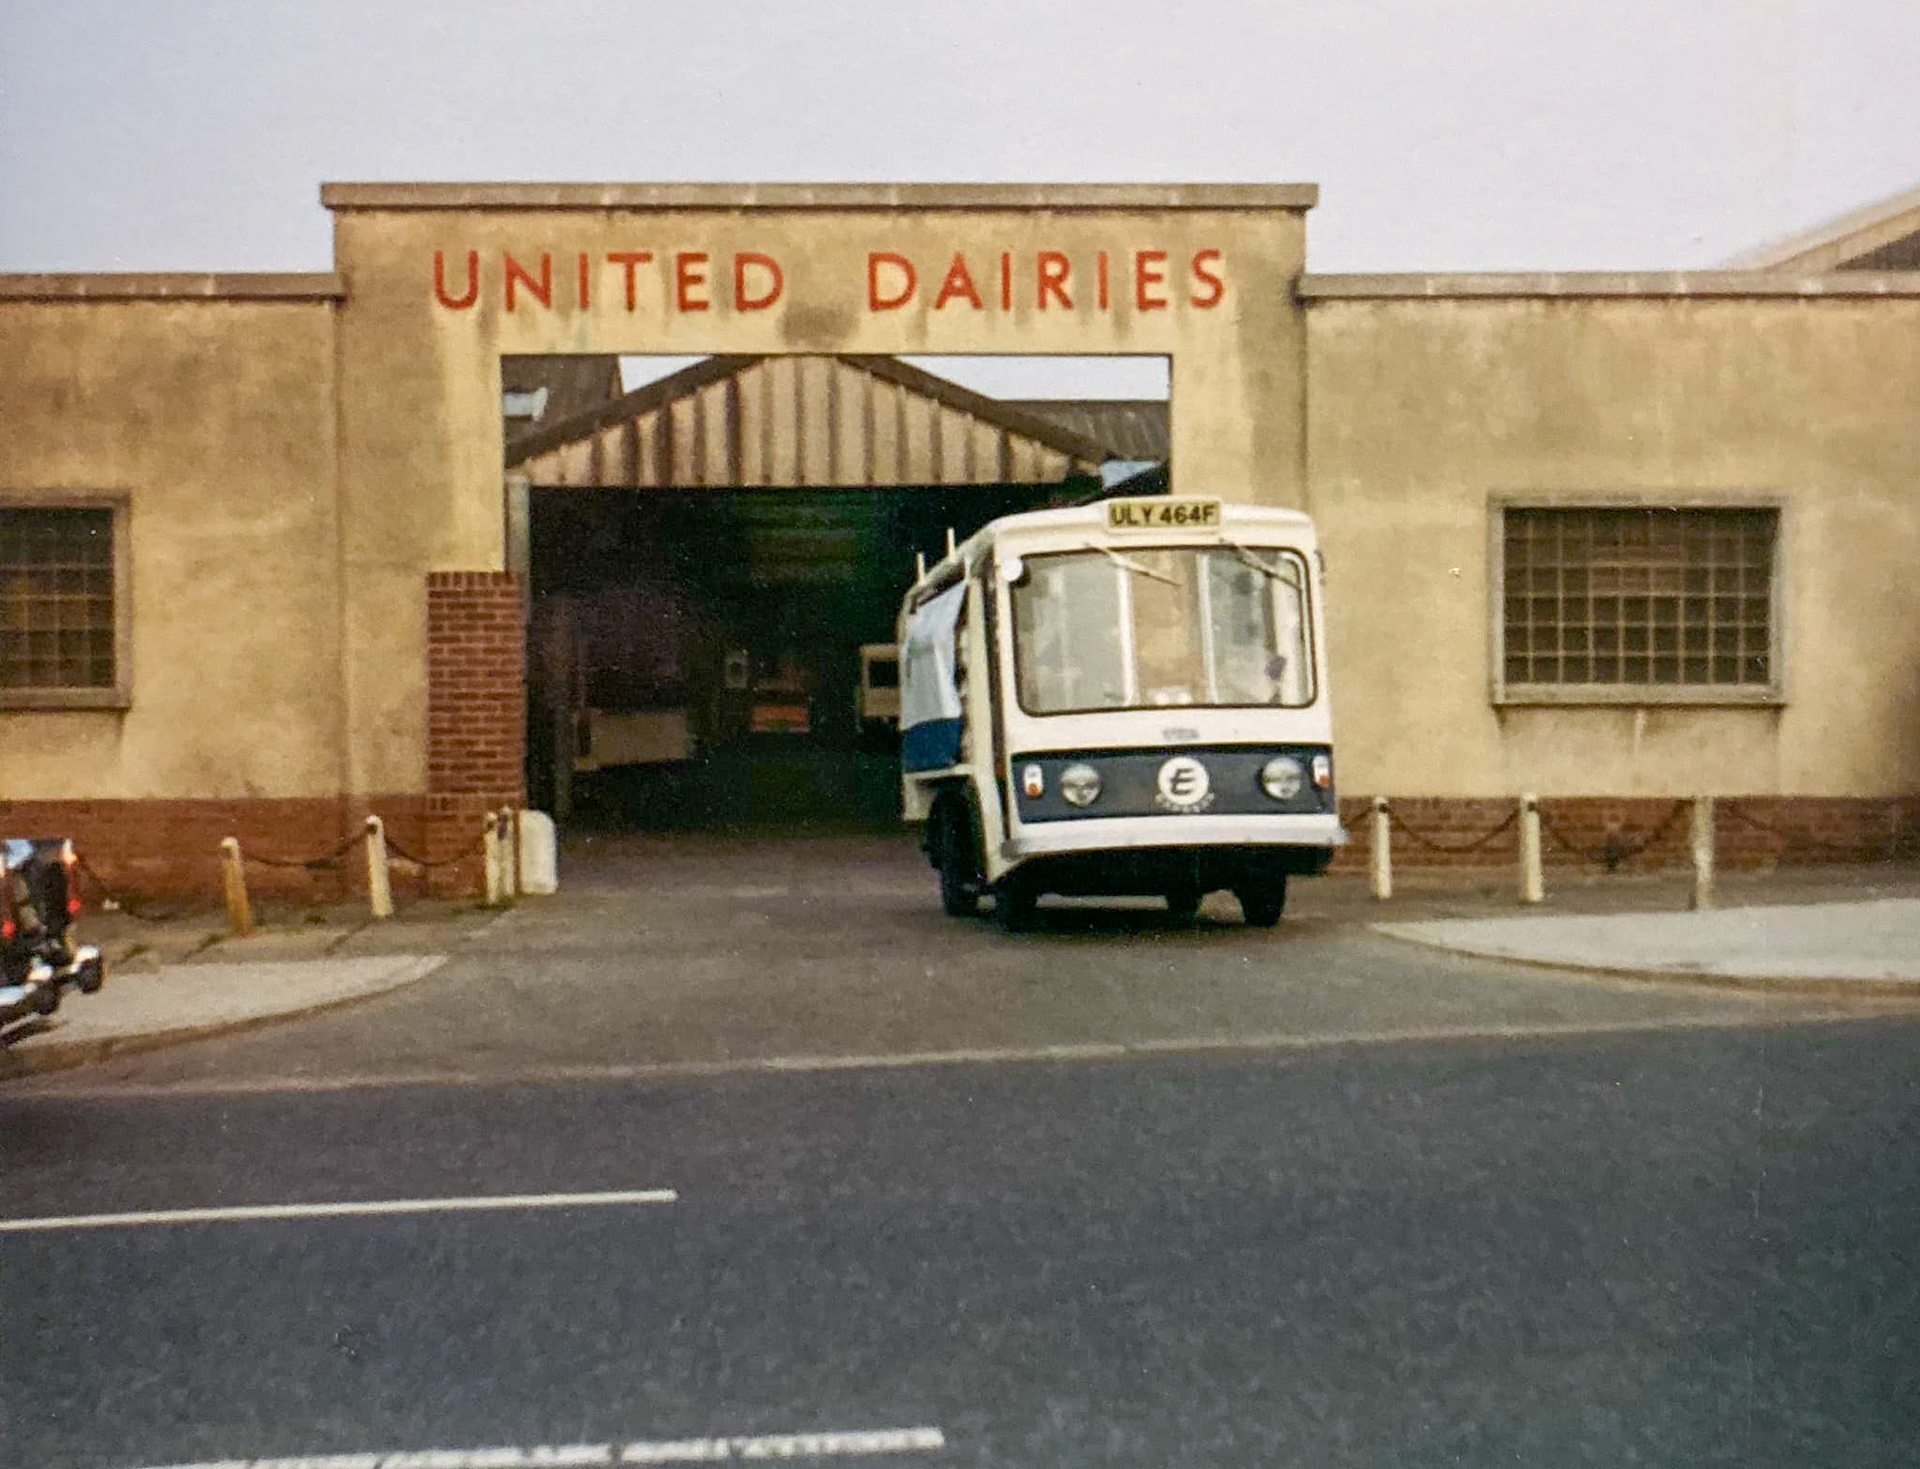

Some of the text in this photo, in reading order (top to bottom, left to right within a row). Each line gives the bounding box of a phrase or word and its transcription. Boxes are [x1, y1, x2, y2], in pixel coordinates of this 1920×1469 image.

[431, 247, 1225, 312] UNITED DAIRIES
[1110, 503, 1216, 526] ULY 464F
[1170, 767, 1196, 796] E
